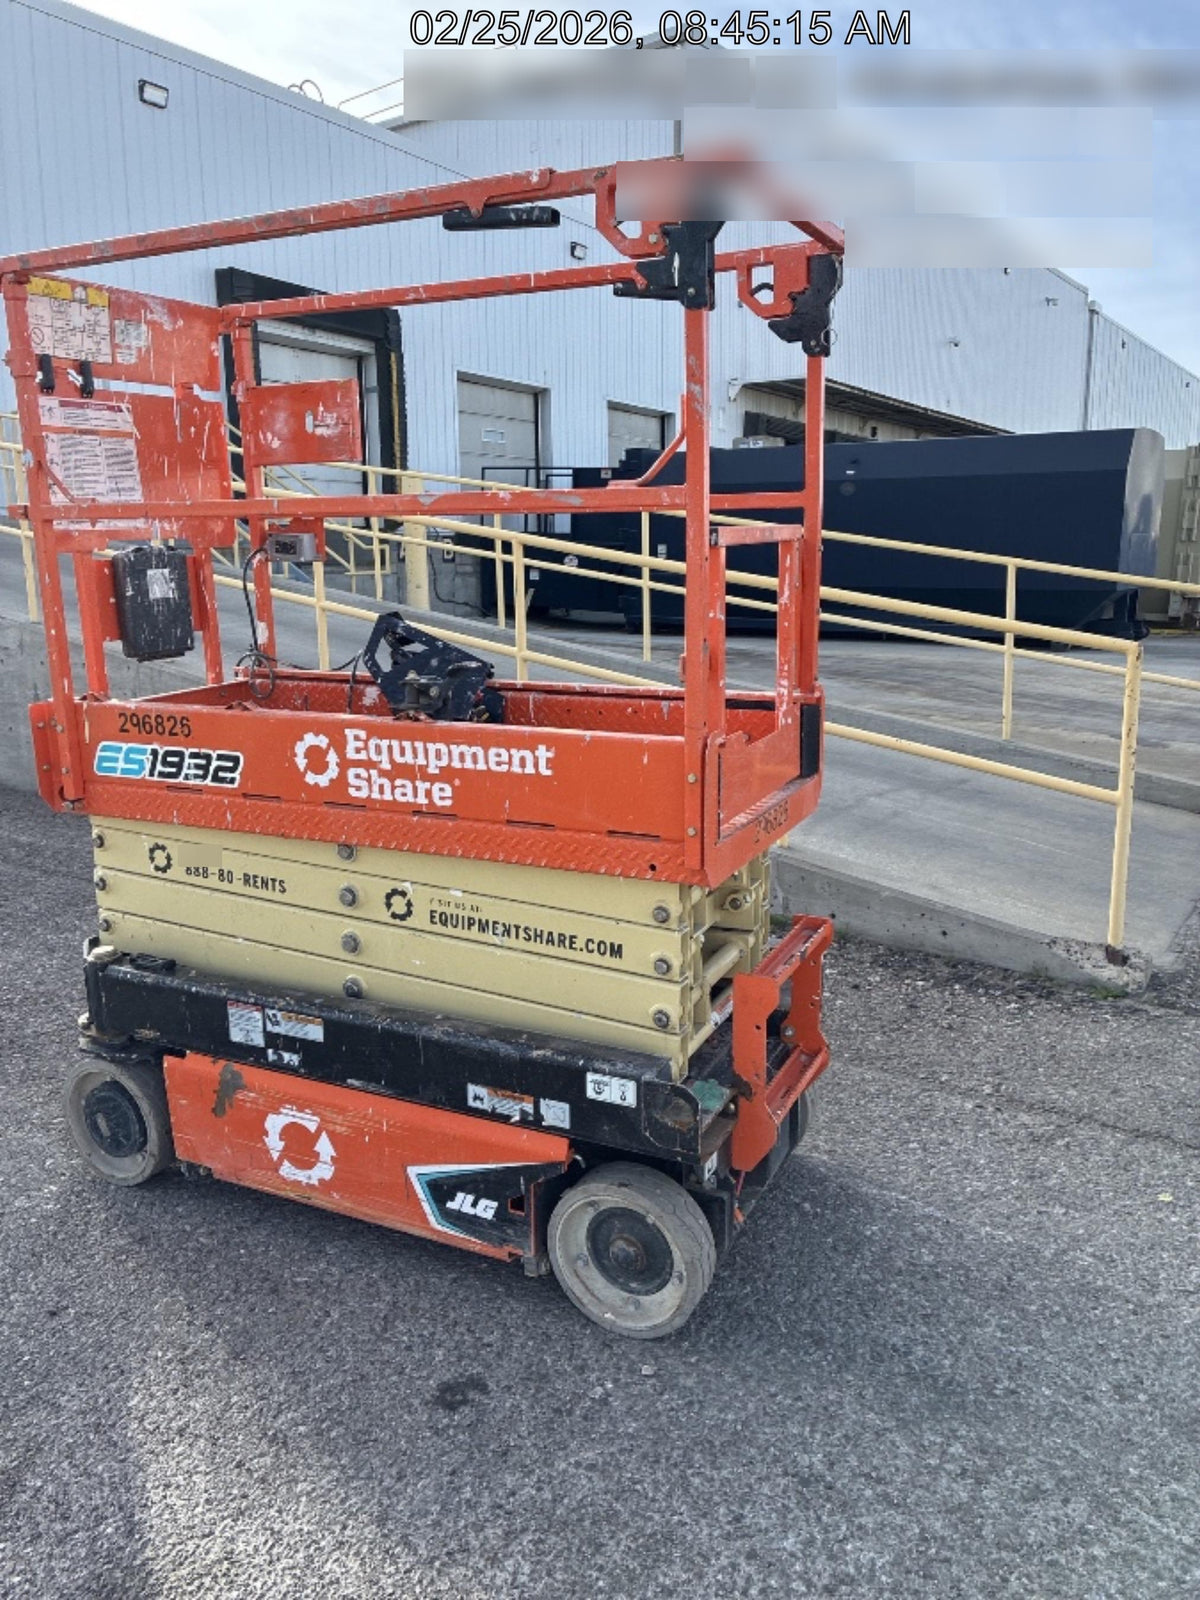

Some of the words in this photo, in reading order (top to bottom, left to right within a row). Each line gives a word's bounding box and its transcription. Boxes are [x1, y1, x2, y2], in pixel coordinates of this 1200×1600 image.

[95, 742, 242, 786] ES1932
[344, 728, 554, 776] Equipment
[346, 767, 453, 806] Share
[429, 909, 623, 959] EQUIPMENTSHARE.COM
[446, 1191, 499, 1220] JLG
